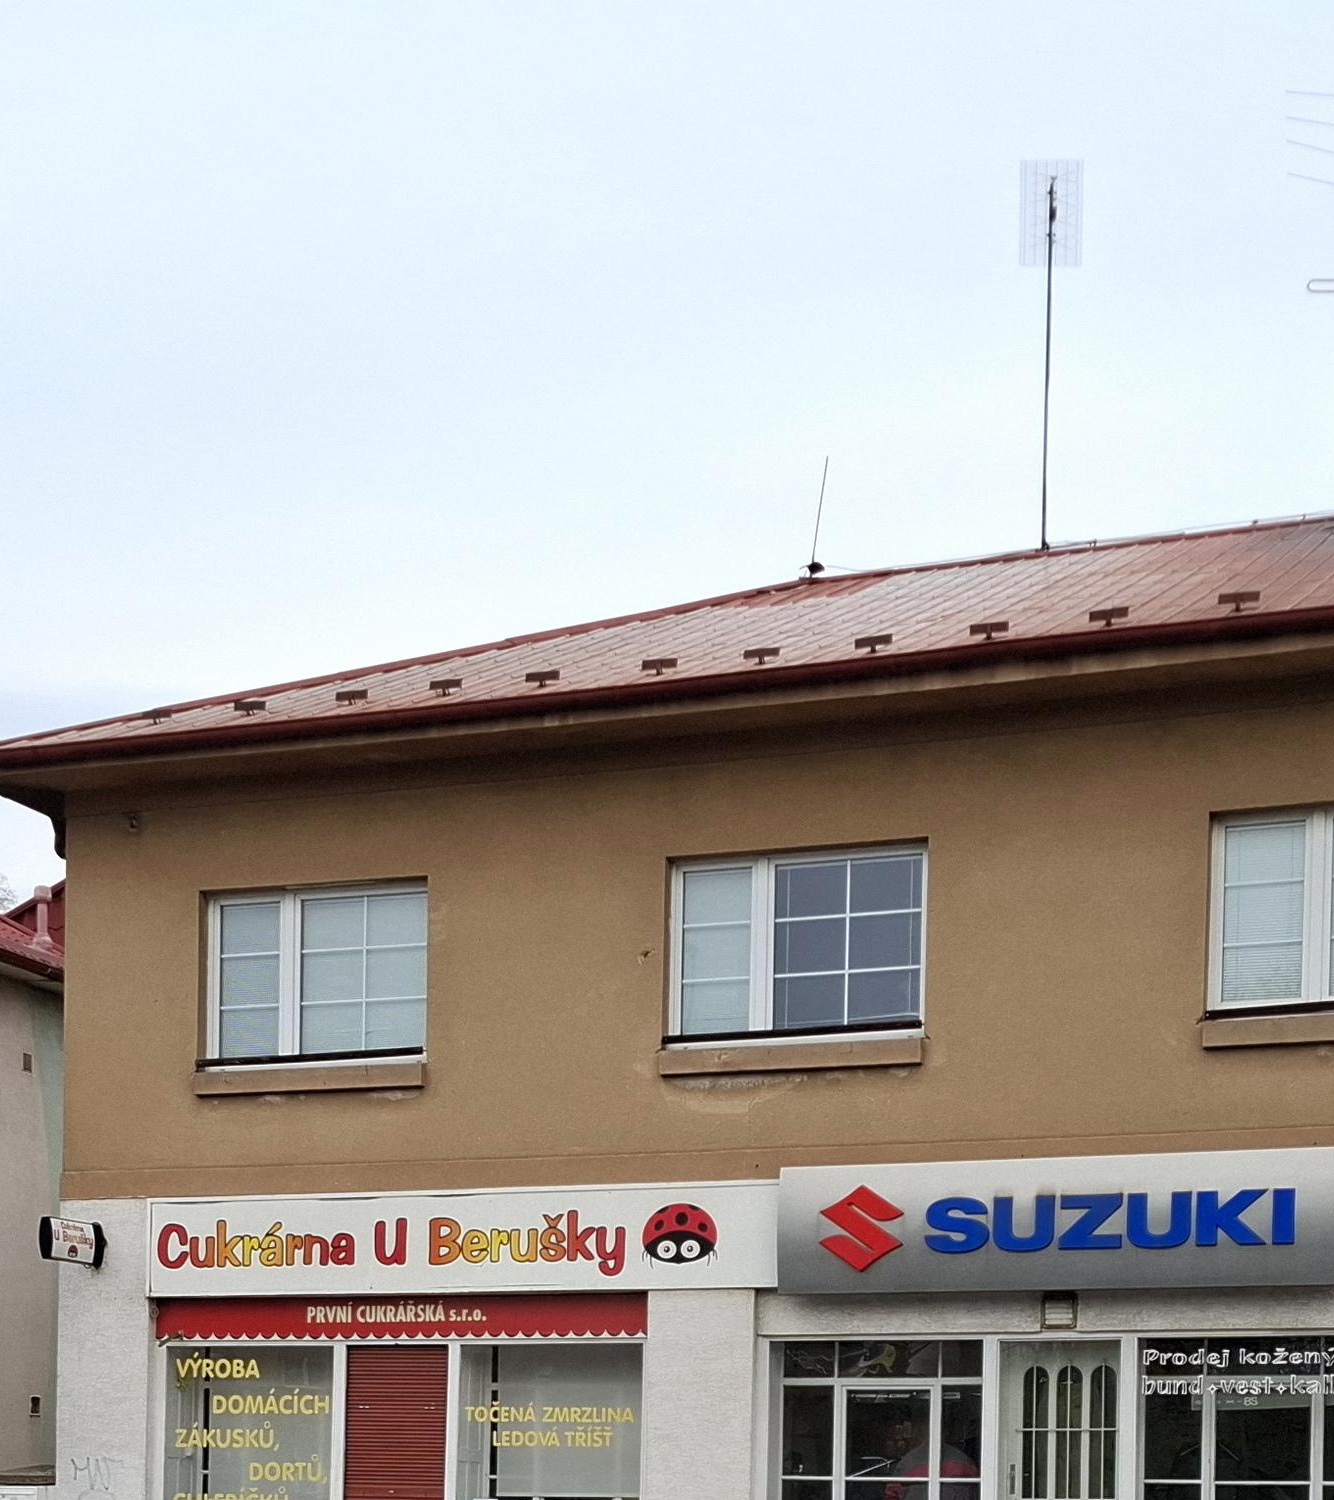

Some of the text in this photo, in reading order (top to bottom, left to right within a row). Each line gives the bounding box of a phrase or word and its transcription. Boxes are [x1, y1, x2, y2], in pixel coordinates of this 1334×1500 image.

[923, 1187, 1297, 1255] SUZUKI
[156, 1209, 628, 1277] Cukrárna U Berušky
[306, 1300, 488, 1324] PRVNÍ CUKRÁŘSKÁ s.r.o.
[176, 1351, 261, 1379] VÝROBA
[1142, 1347, 1230, 1368] Prodej
[1141, 1374, 1204, 1395] bund
[1220, 1376, 1274, 1395] vest
[212, 1387, 331, 1415] DOMÁCÍCH
[464, 1401, 635, 1424] TOČENÁ ZMRZLINA
[174, 1421, 280, 1452] ZÁKUSKŮ,
[492, 1425, 614, 1448] LEDOVÁ TŘÍŠŤ
[248, 1454, 328, 1485] DORTŮ,
